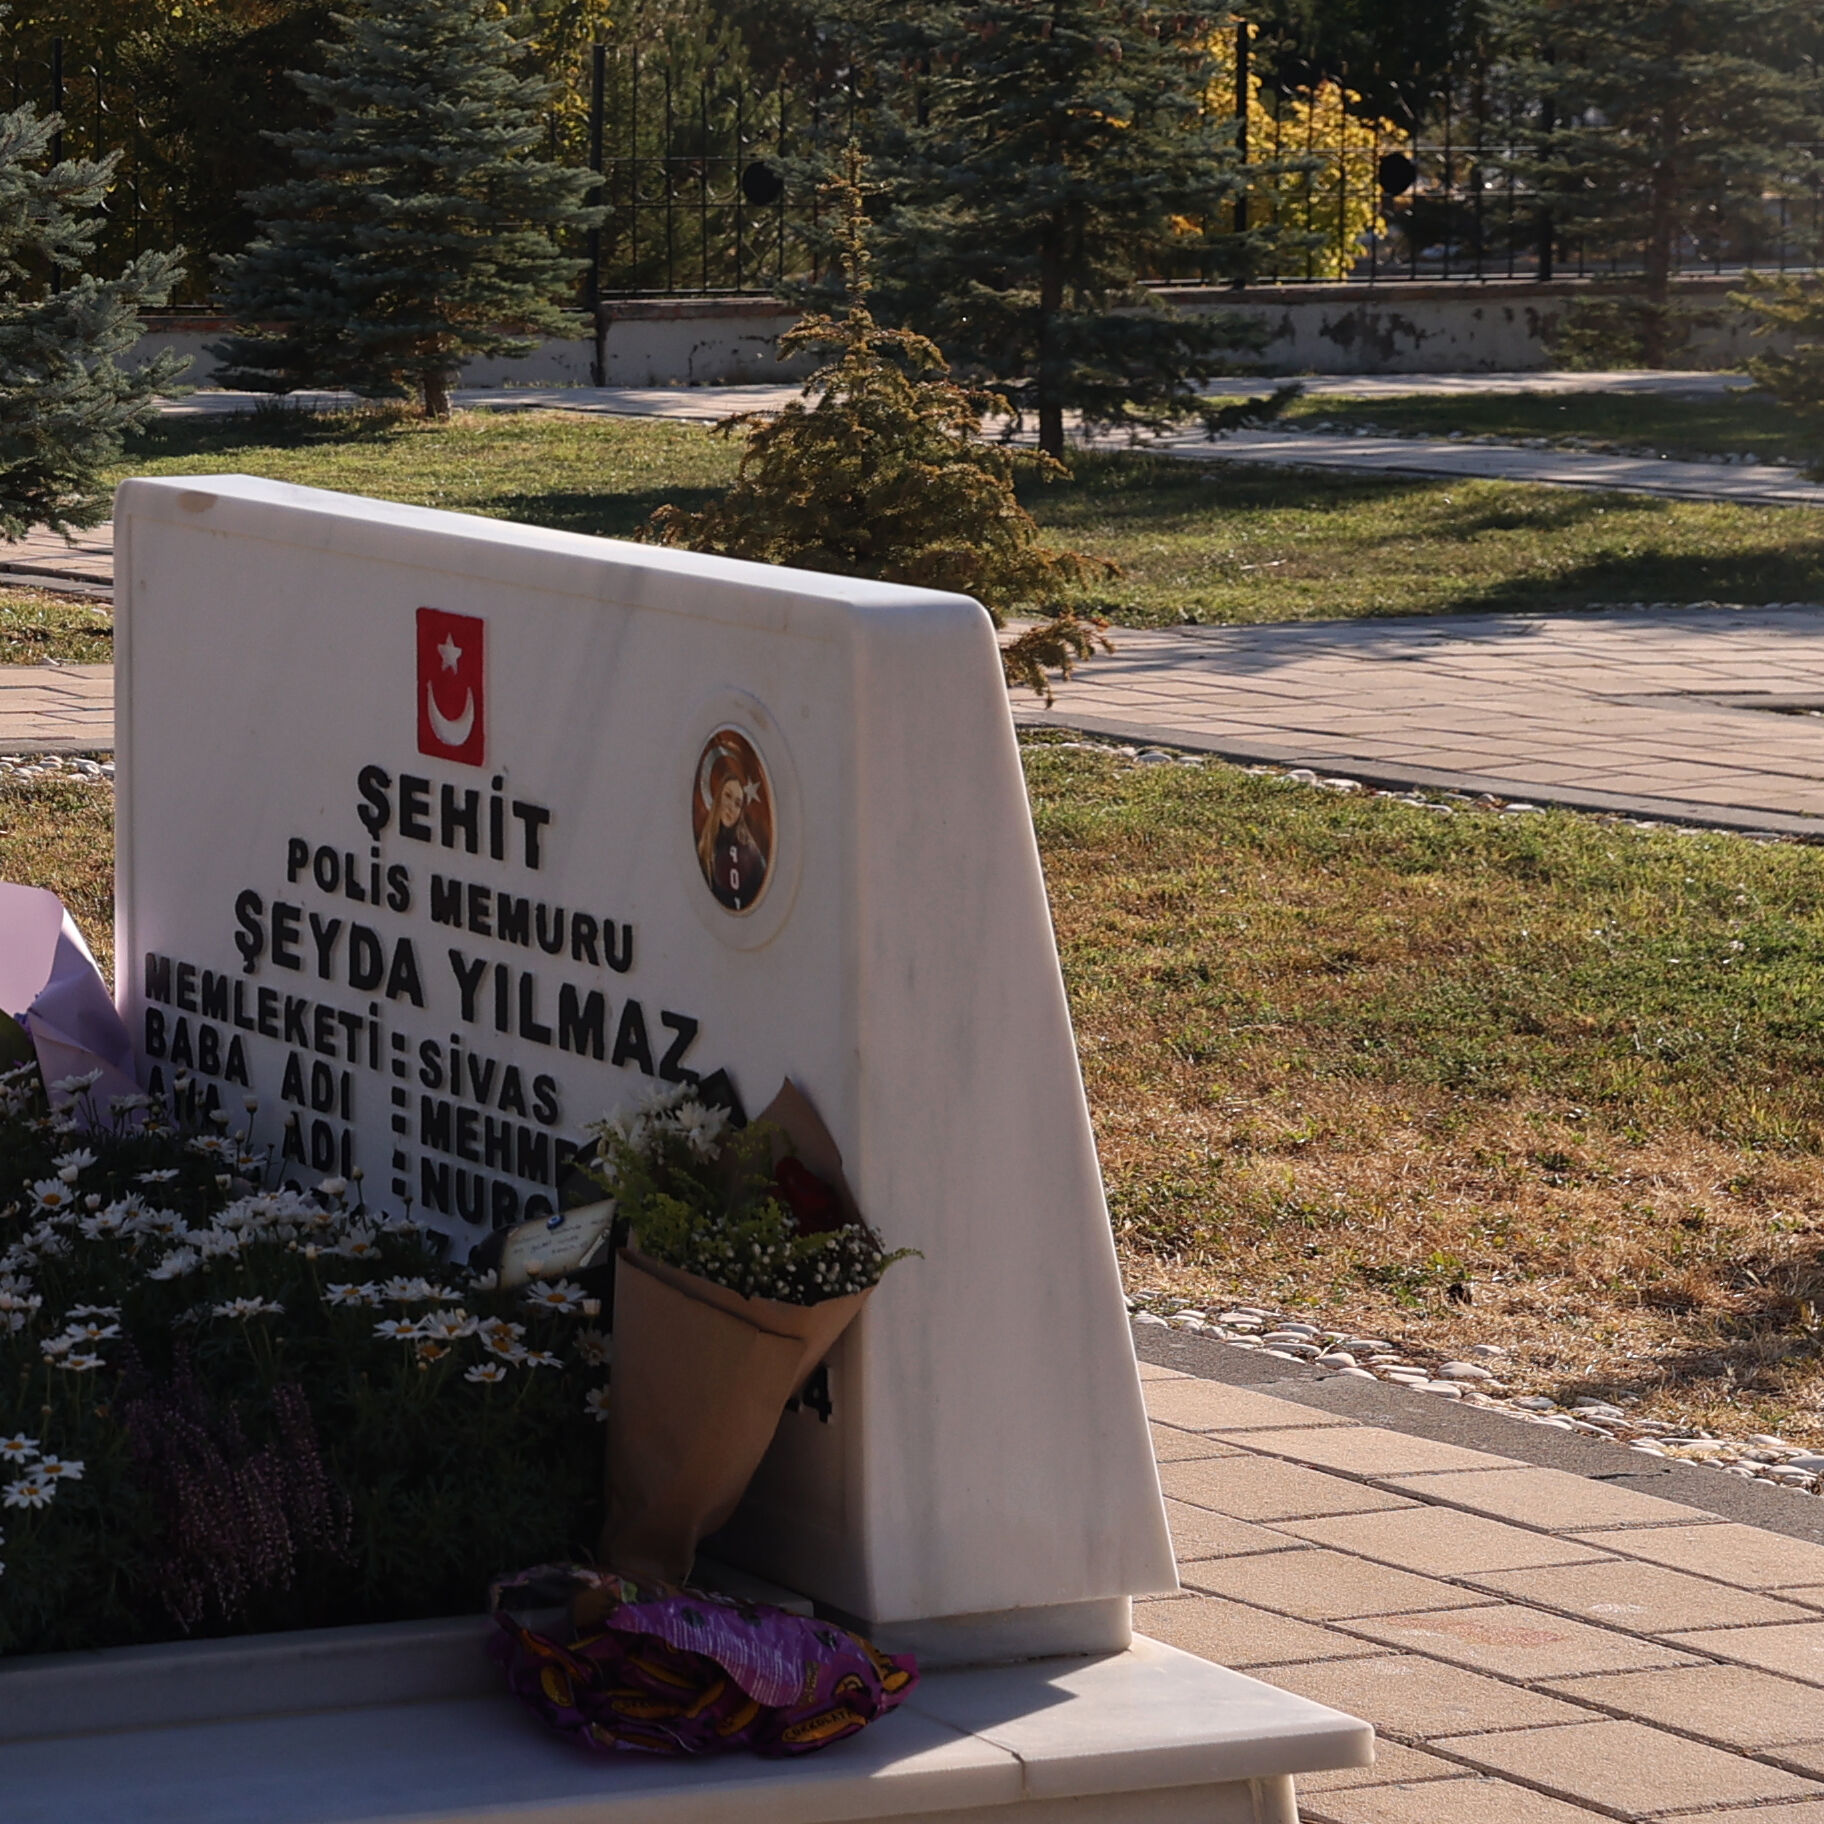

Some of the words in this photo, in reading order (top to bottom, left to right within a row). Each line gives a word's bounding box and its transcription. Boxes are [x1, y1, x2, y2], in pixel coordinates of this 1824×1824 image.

[357, 764, 550, 869] ŞEHİT
[288, 837, 410, 912] POLİS
[431, 875, 633, 973] MEMURU
[235, 889, 424, 1007] ŞEYDA
[448, 948, 699, 1083] YILMAZ
[145, 1008, 248, 1087] BABA
[281, 1050, 351, 1121] ADI
[281, 1111, 351, 1177] ADI
